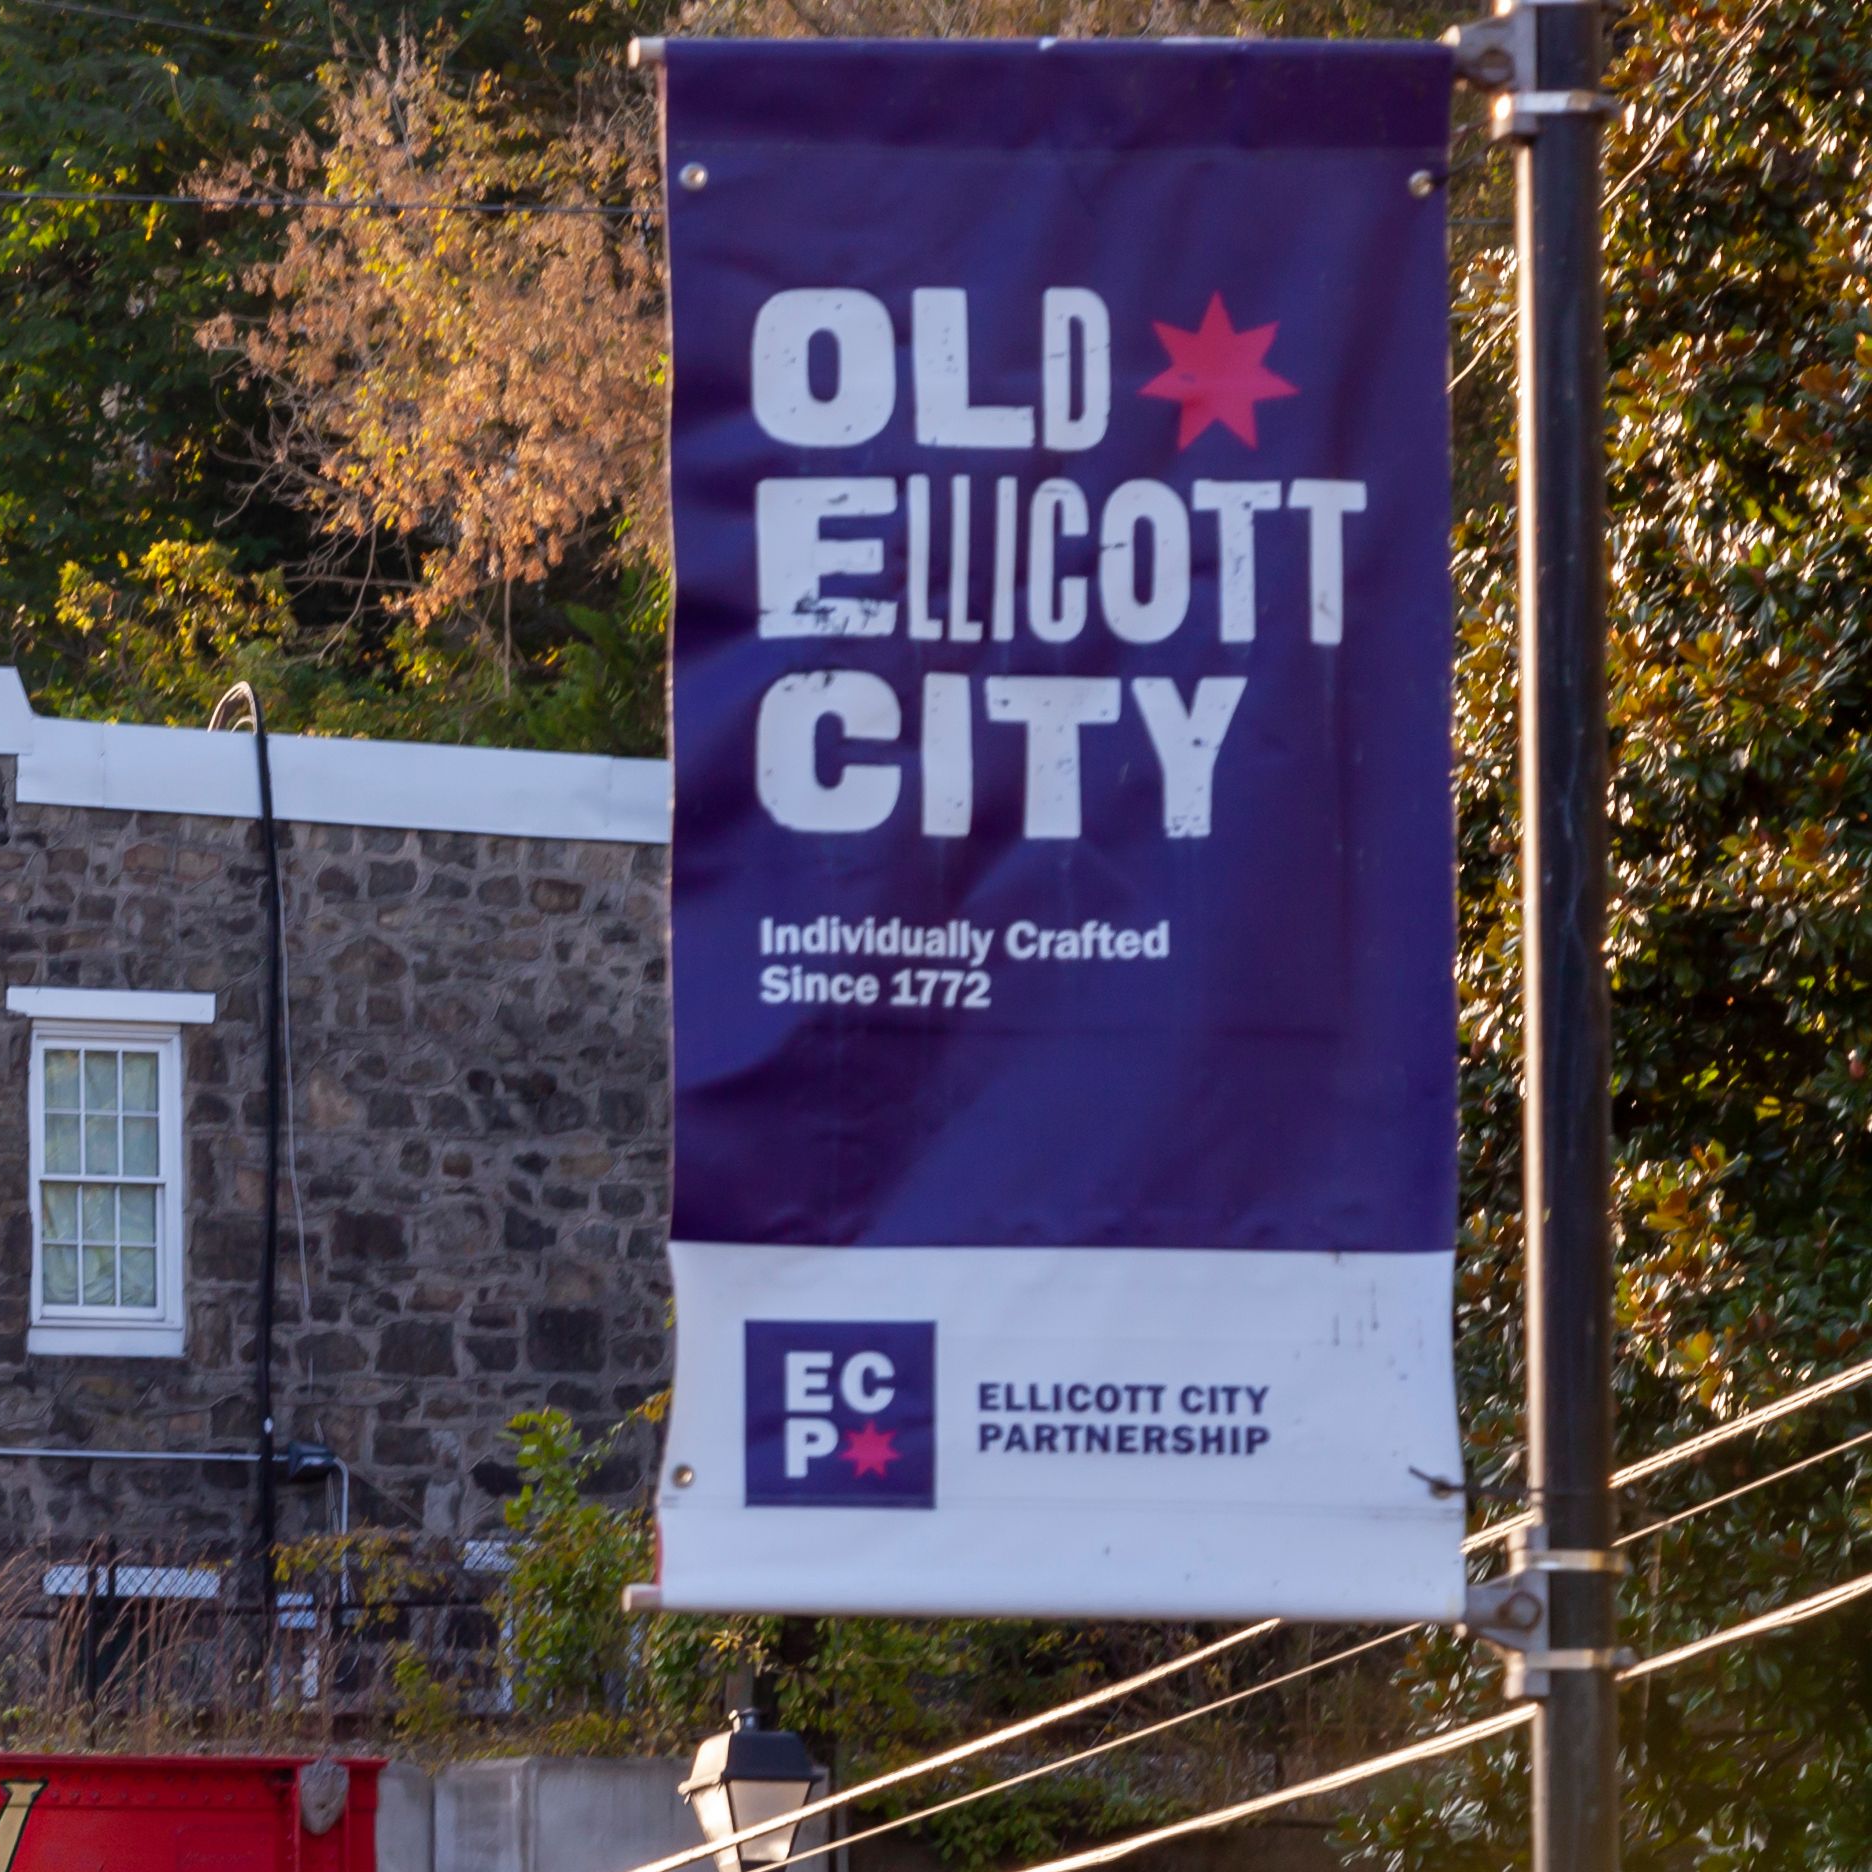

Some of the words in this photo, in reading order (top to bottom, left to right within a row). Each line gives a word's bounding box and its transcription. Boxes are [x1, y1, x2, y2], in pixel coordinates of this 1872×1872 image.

[750, 286, 1111, 452] OLD
[755, 474, 1369, 646] ELLICOTT
[755, 669, 1249, 841] CITY
[759, 916, 995, 968] Individually
[1004, 920, 1171, 961] Crafted
[759, 966, 880, 1005] Since
[890, 970, 992, 1008] 1772
[784, 1350, 896, 1415] EC
[977, 1383, 1166, 1416] ELLICOTT
[1179, 1385, 1271, 1417] CITY
[784, 1418, 839, 1480] P
[977, 1423, 1271, 1457] PARTNERSHIP
